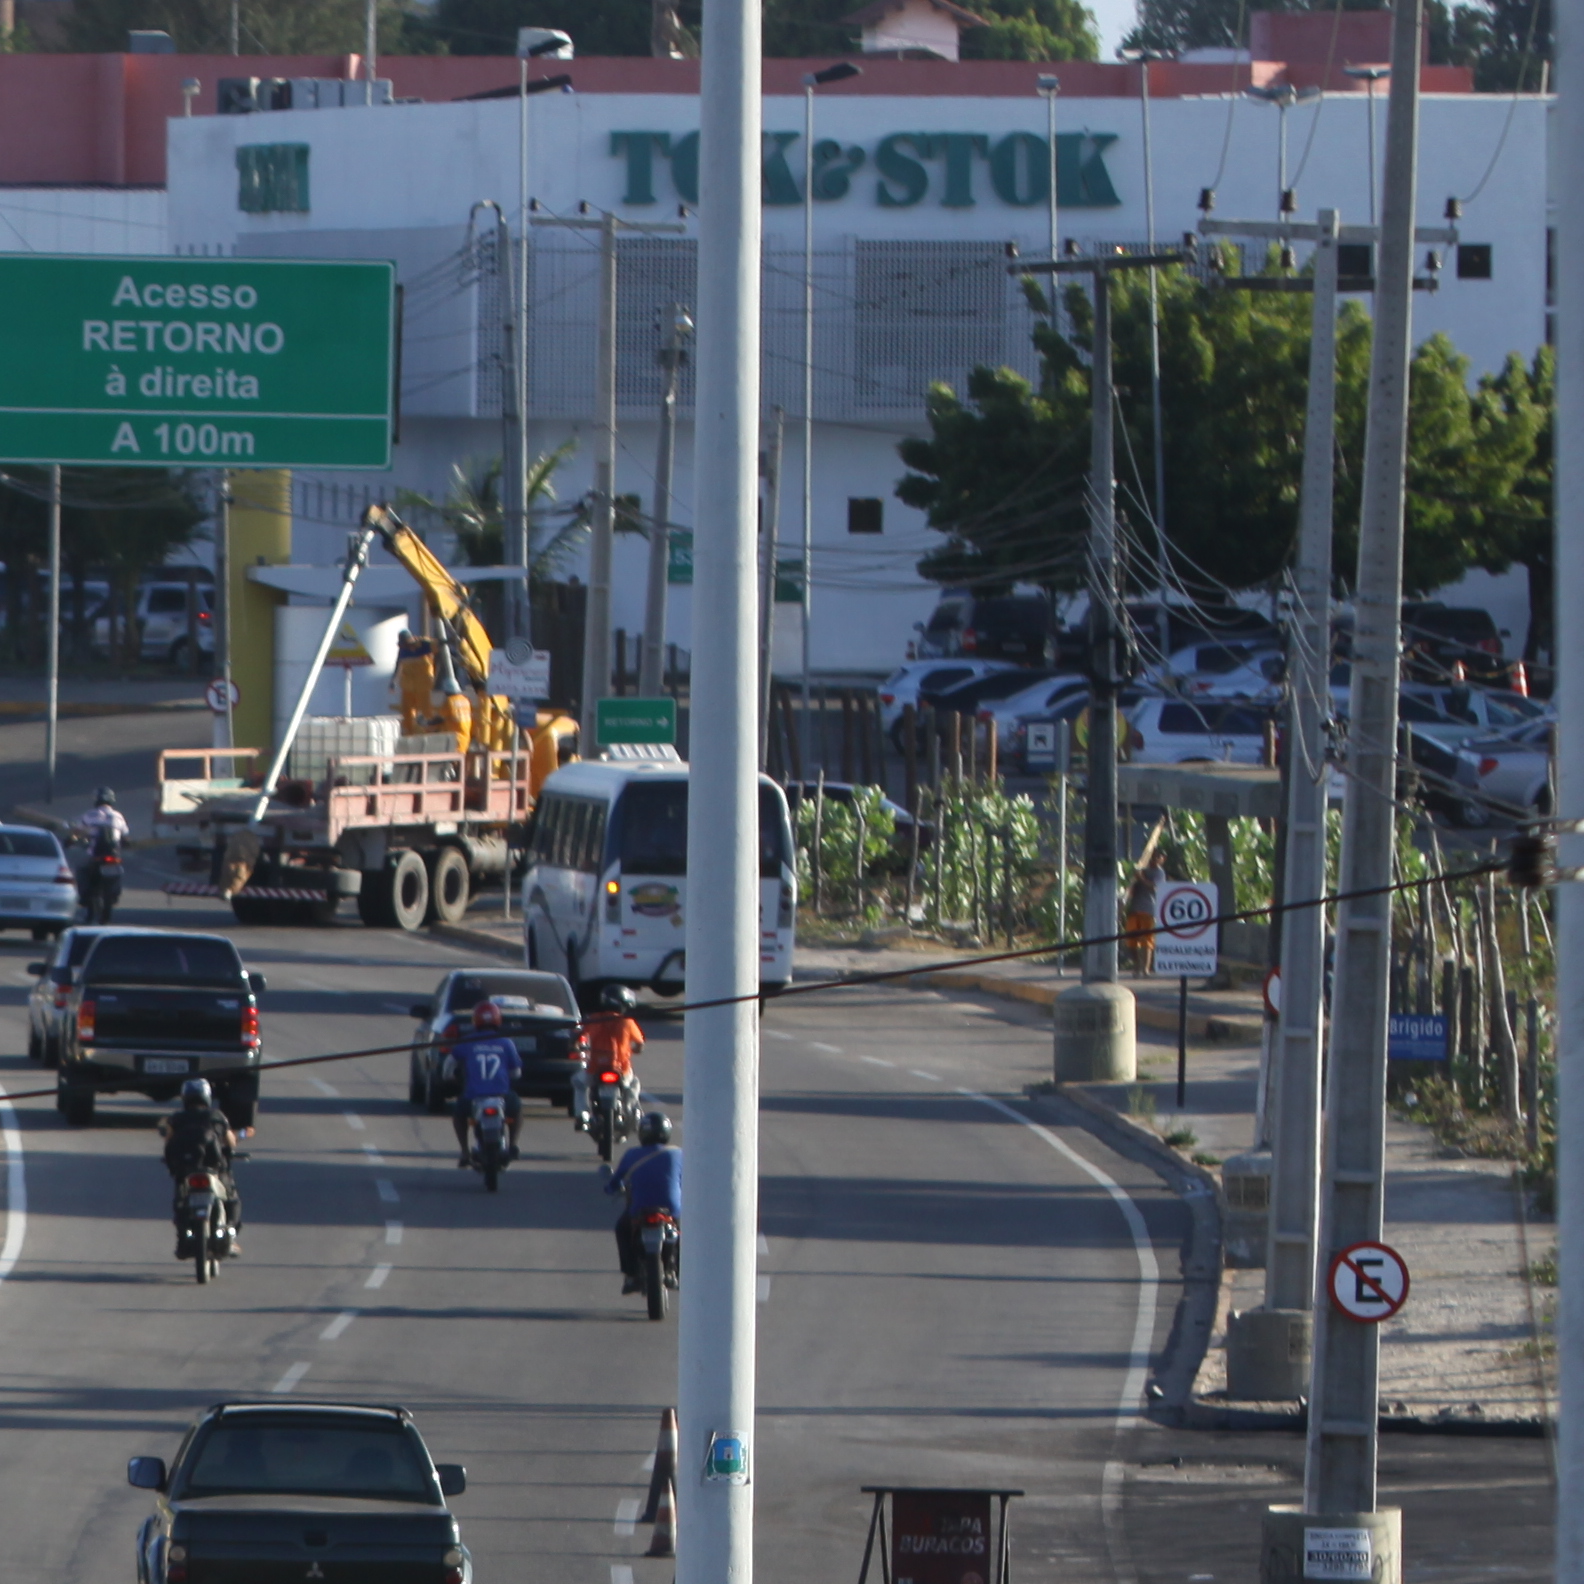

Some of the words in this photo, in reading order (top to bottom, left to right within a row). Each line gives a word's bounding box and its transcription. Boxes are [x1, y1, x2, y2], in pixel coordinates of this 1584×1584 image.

[111, 276, 258, 310] Acesso
[82, 320, 285, 356] RETORNO
[105, 365, 127, 397] à
[138, 365, 260, 399] direita
[110, 422, 140, 454] A
[152, 422, 256, 455] 100m
[1169, 898, 1203, 920] 60
[475, 1053, 502, 1081] 17
[1355, 1258, 1384, 1303] E
[899, 1534, 986, 1555] BURACOS
